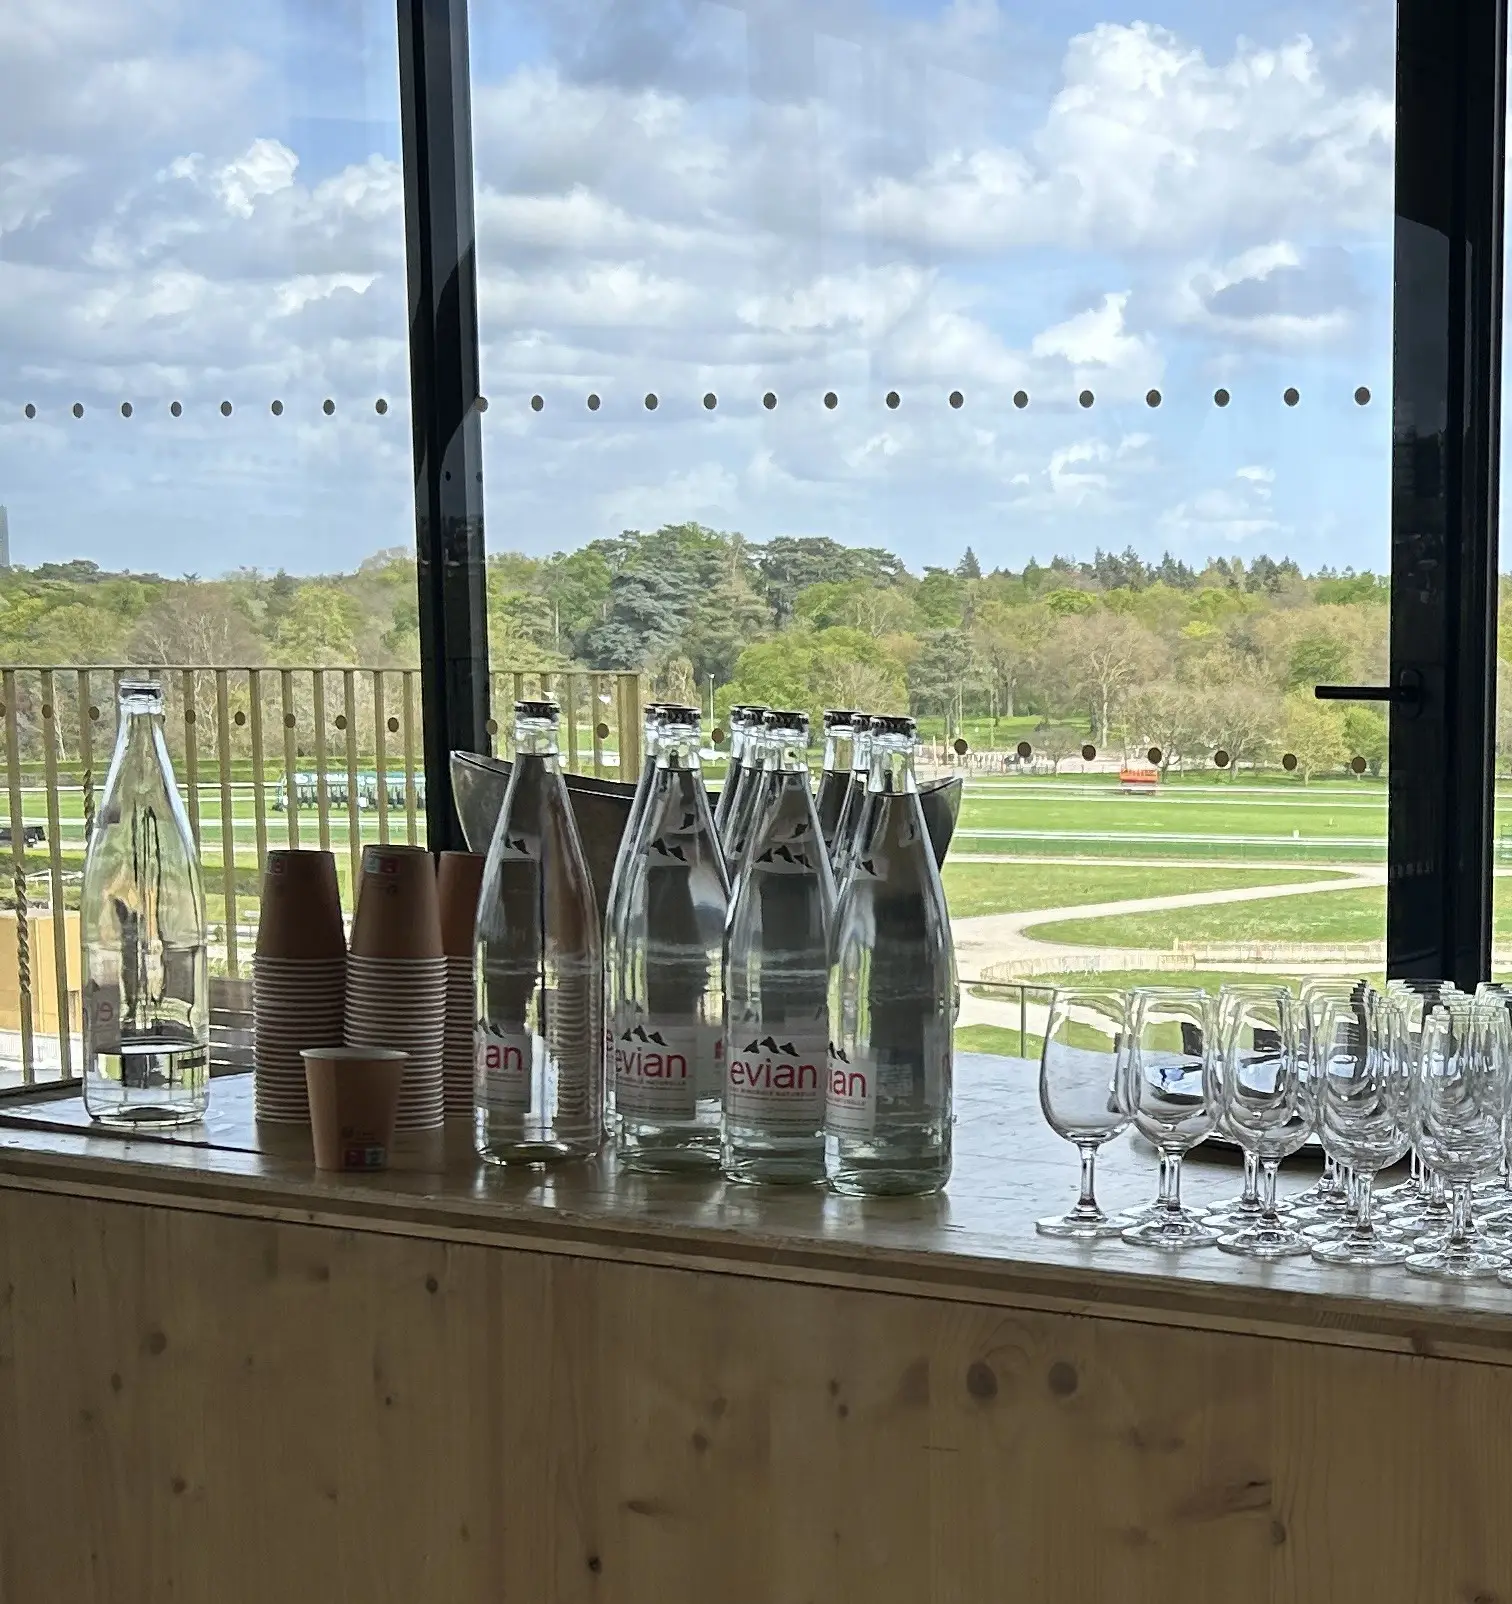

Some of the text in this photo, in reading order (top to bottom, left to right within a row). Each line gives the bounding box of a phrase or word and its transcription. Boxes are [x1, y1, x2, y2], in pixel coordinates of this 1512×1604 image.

[483, 1043, 523, 1071] an
[615, 1046, 688, 1079] evian
[729, 1057, 818, 1089] evian
[828, 1062, 867, 1098] ian
